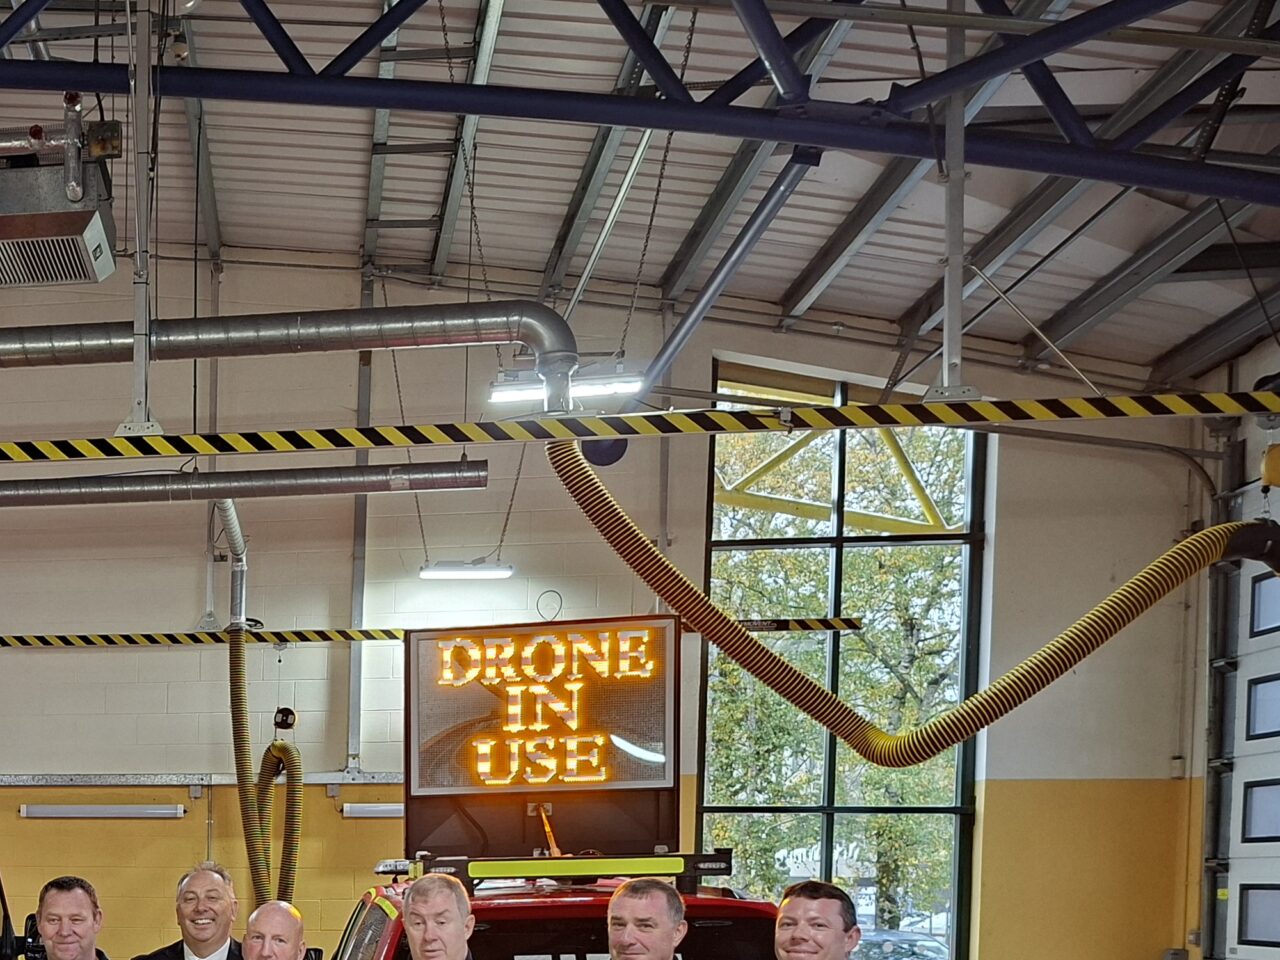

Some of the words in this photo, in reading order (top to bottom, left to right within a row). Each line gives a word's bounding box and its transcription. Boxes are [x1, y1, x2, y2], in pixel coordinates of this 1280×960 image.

[438, 630, 654, 687] DRONE
[503, 682, 584, 733] IN
[472, 734, 607, 785] USE
